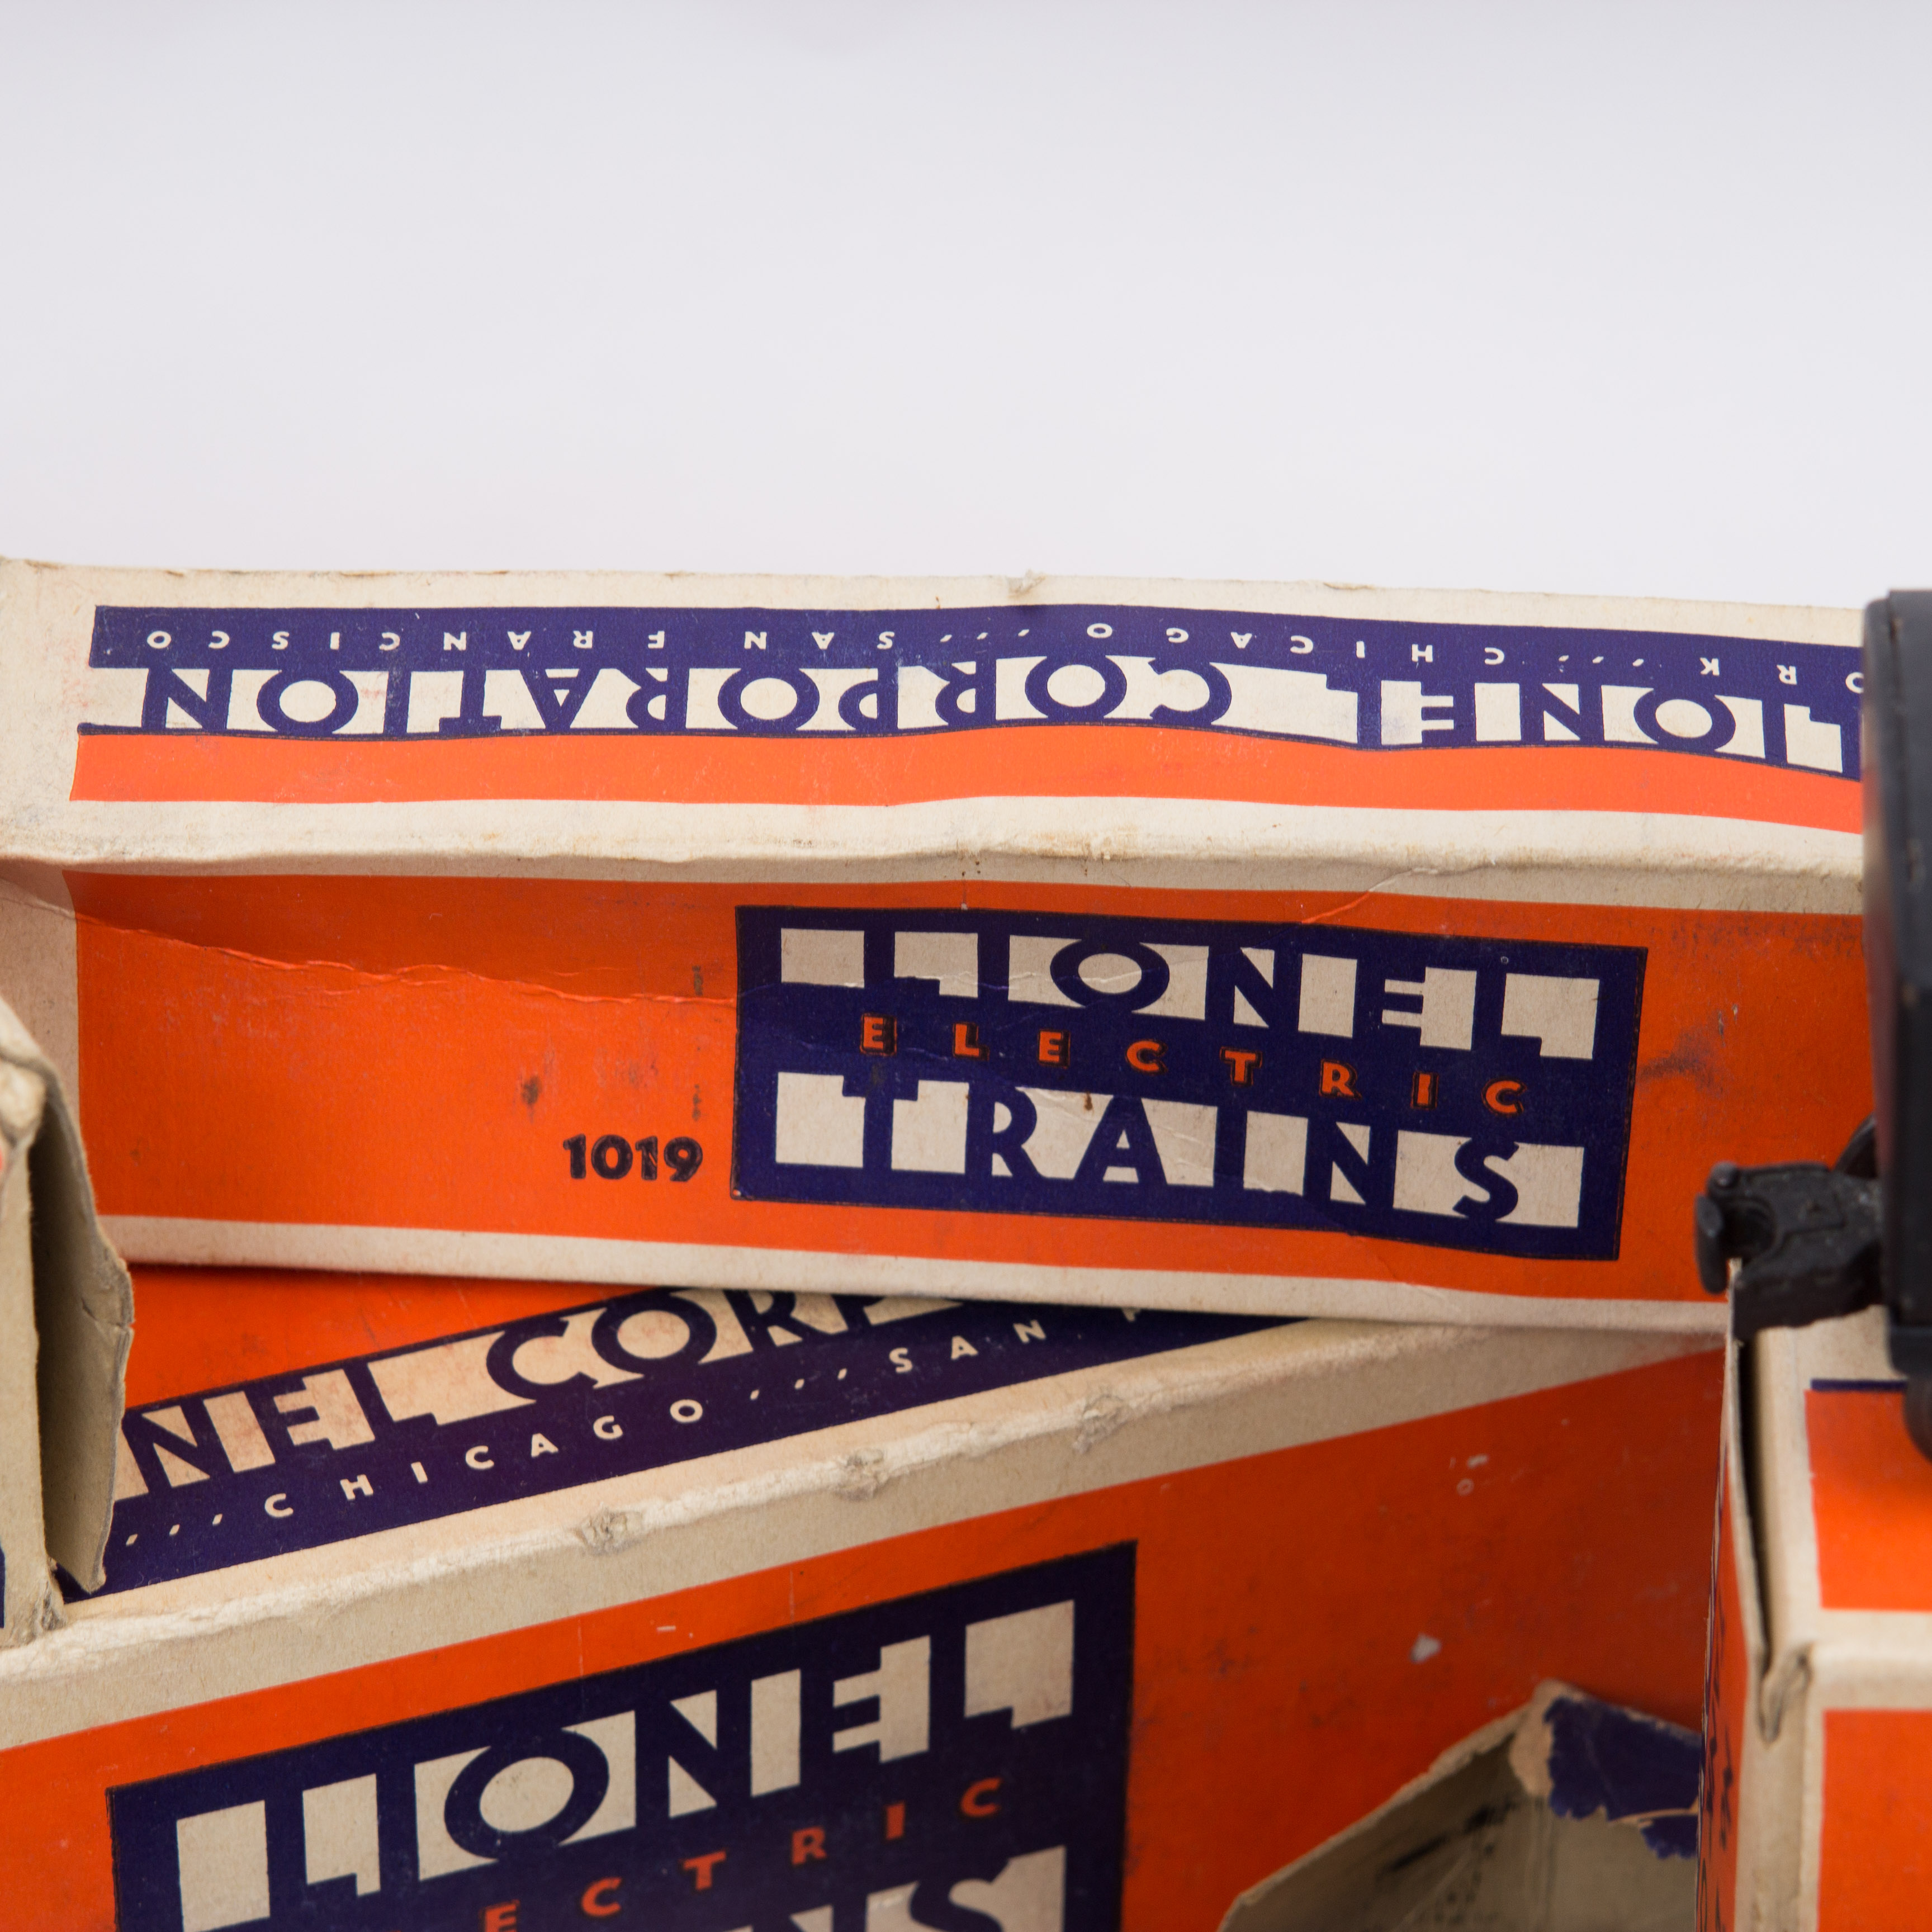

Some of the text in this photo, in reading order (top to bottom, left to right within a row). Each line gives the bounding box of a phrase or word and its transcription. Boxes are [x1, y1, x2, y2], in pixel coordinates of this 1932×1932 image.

[141, 655, 1863, 777] LIONEL CORPORATION
[146, 623, 1864, 694] ORK CHICAGO SAN FRANCISCO
[863, 929, 1541, 1060] LIONEL
[861, 1012, 1529, 1117] ELECTRIC
[563, 1133, 703, 1182] 1019
[843, 1072, 1519, 1224] TRAINS
[122, 1357, 439, 1494] NEL
[264, 1320, 1046, 1518] CHICAGO SAN
[265, 1624, 1013, 1919] LIONEL
[389, 1778, 1002, 1932] ECTRIC
